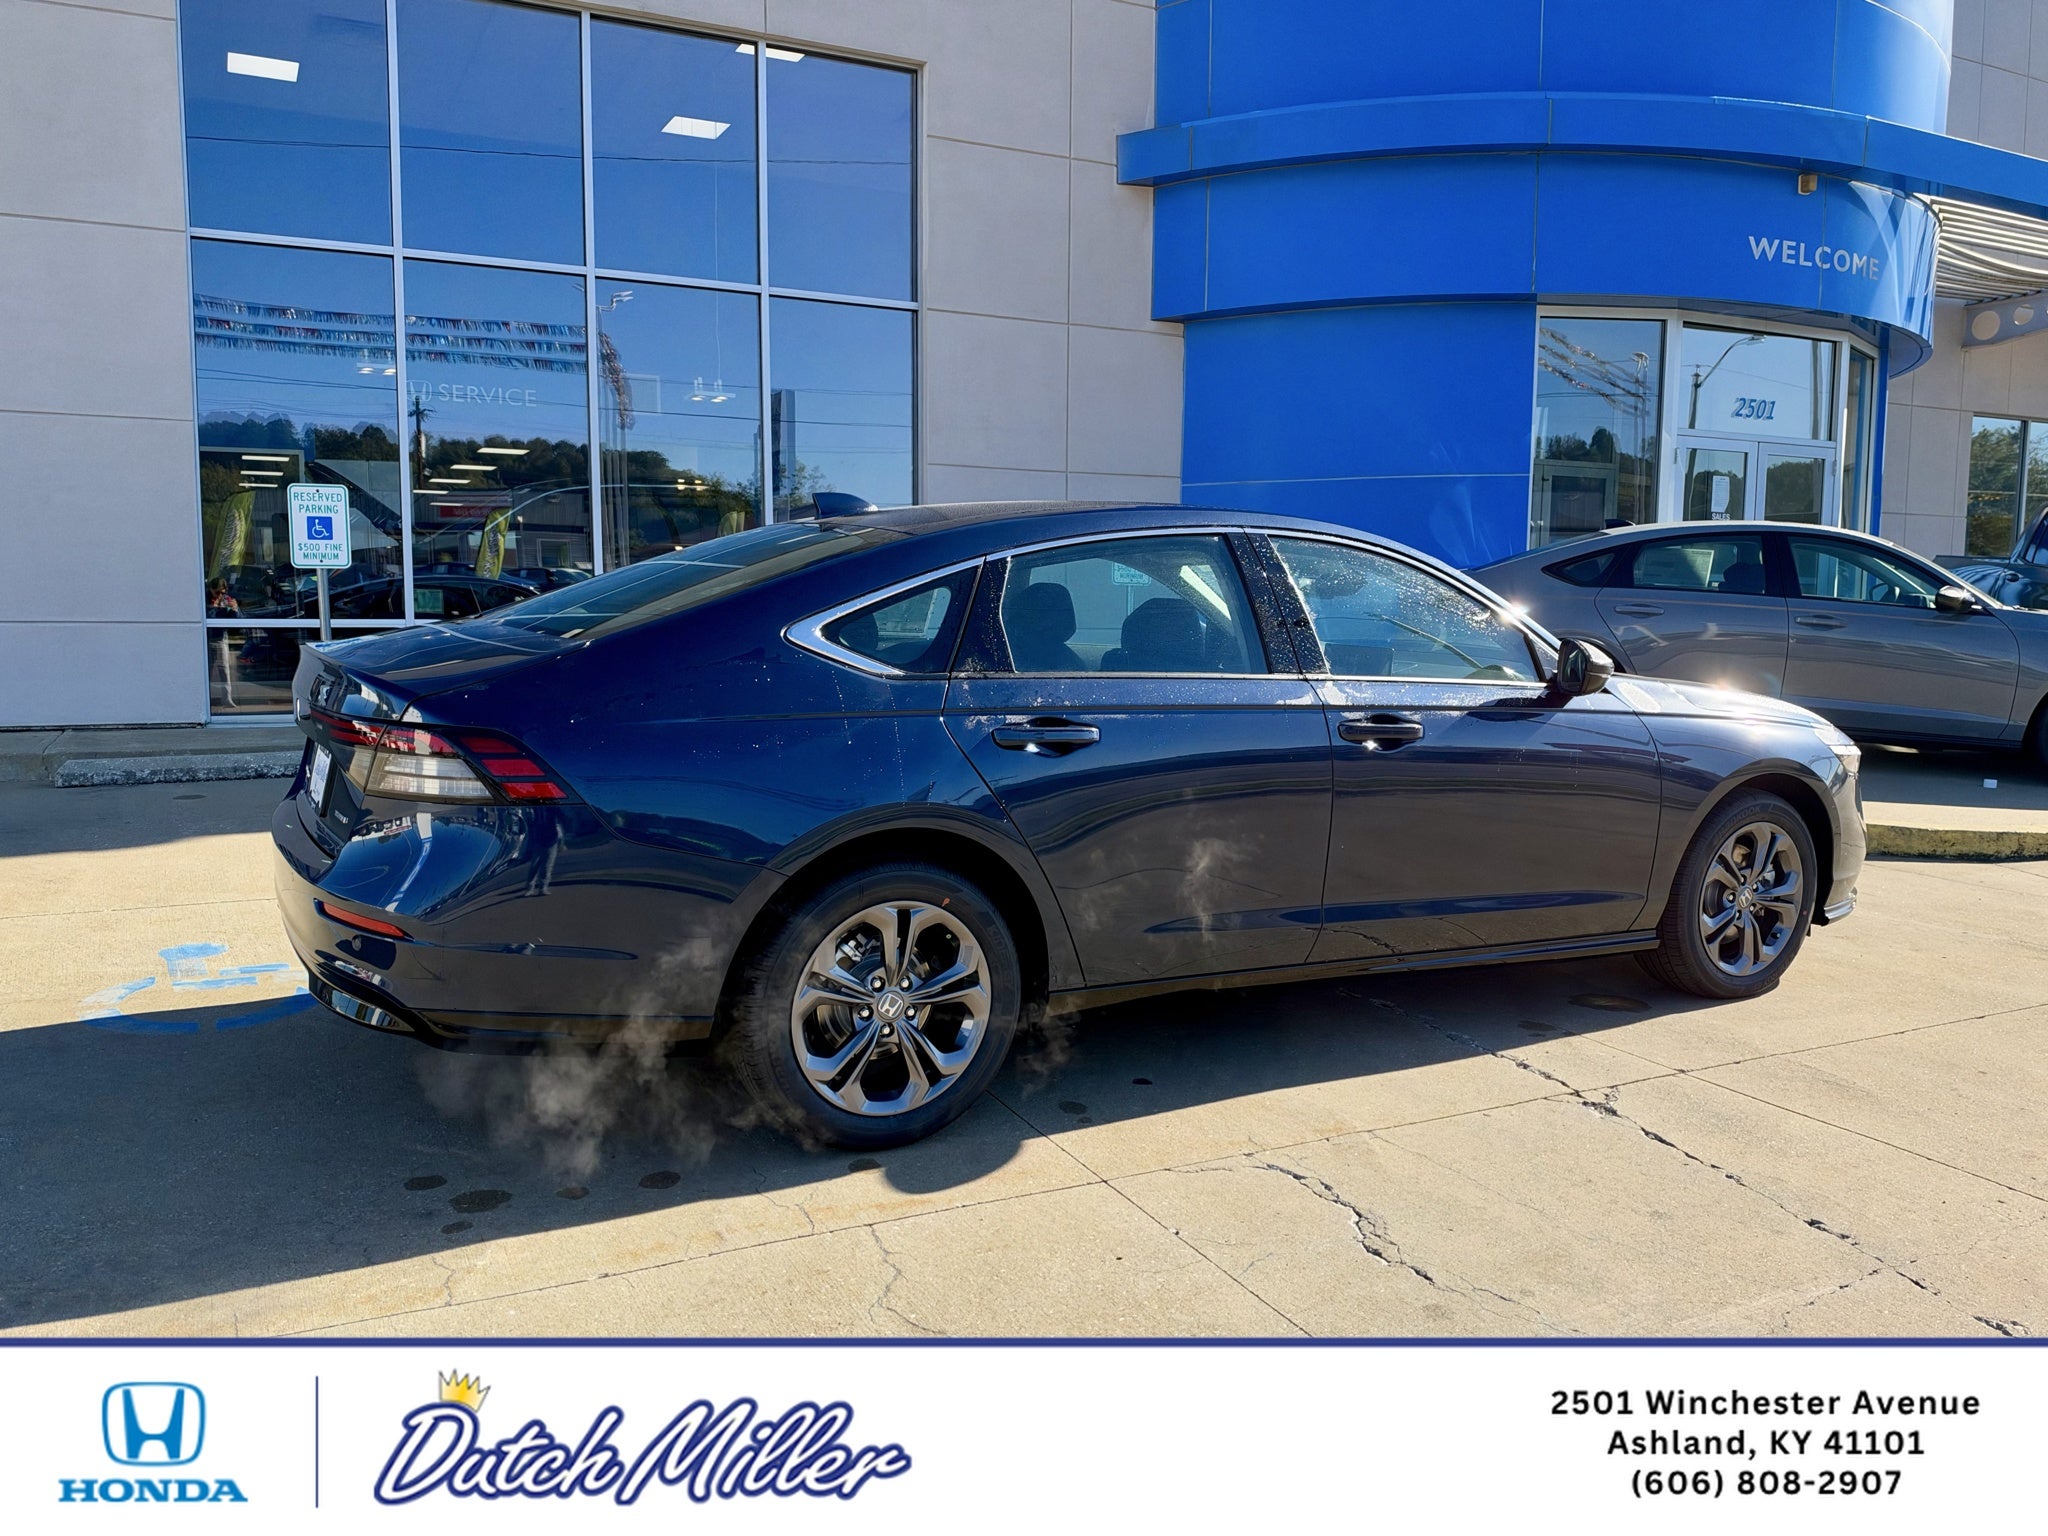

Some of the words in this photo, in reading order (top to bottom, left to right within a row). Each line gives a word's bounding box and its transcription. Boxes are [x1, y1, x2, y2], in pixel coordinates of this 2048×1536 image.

[1748, 235, 1879, 281] WELCOME
[439, 383, 537, 407] SERVICE
[1734, 397, 1776, 420] 2501
[293, 491, 343, 502] RESERVED
[298, 504, 339, 514] PARKING
[298, 542, 320, 551] $500
[325, 543, 343, 551] FINE
[303, 551, 339, 560] MINIMUM
